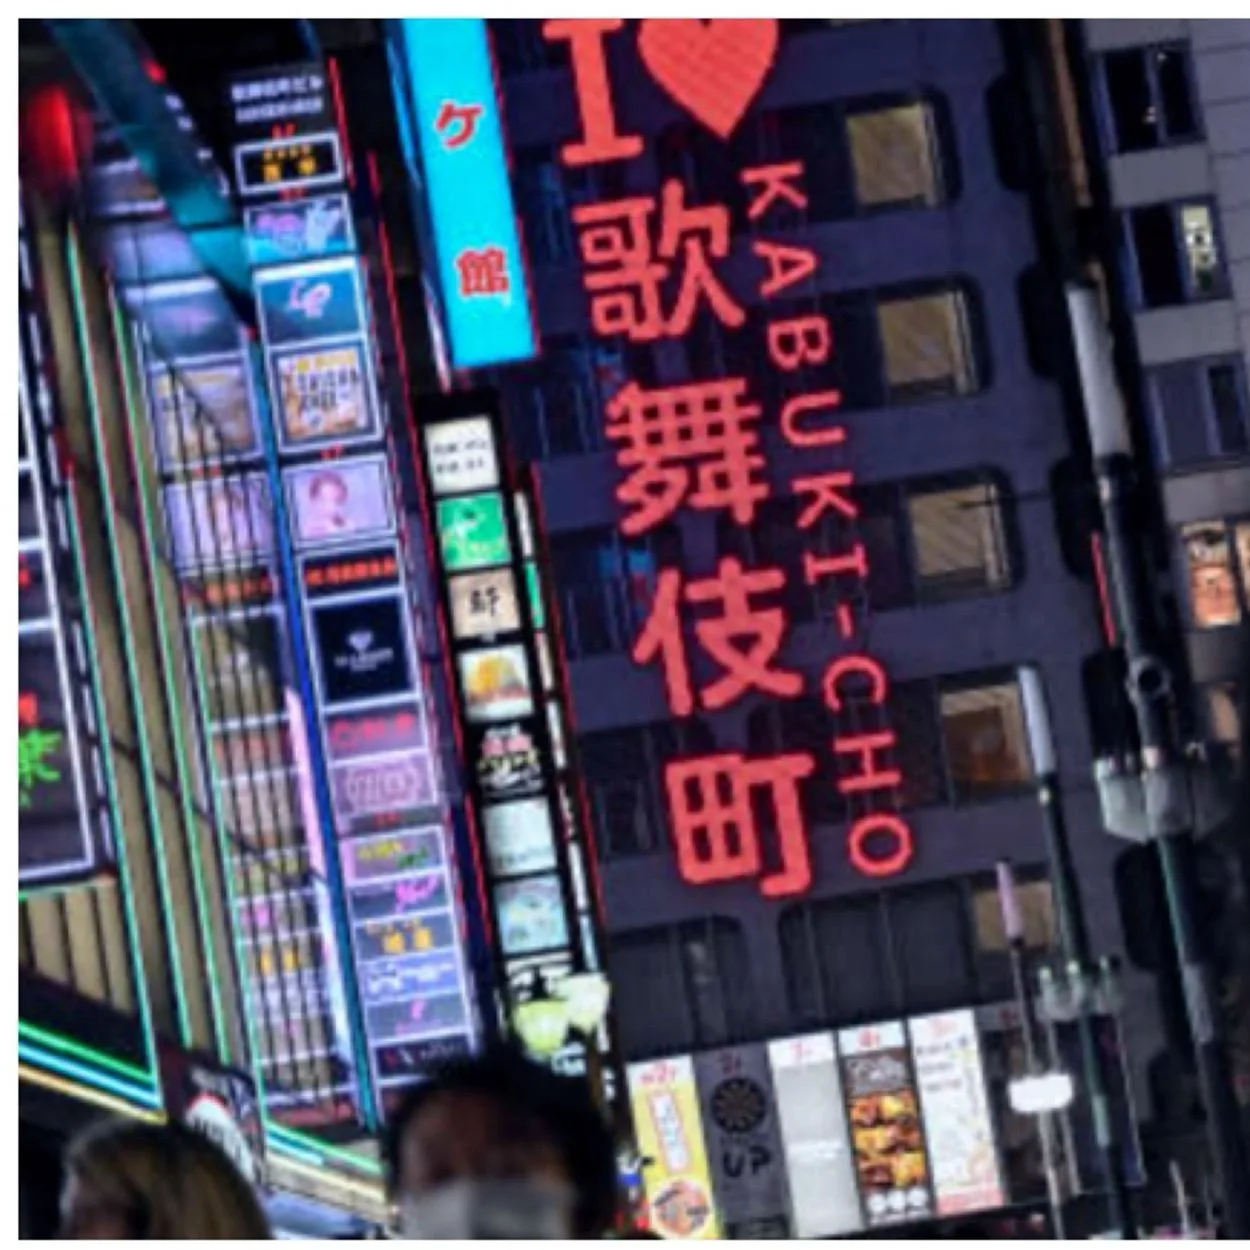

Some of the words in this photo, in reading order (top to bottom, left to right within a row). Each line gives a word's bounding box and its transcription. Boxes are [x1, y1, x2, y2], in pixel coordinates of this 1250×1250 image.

[543, 18, 643, 165] I
[573, 180, 814, 896] 歌舞伎町
[743, 162, 912, 875] KABUKI-CHO
